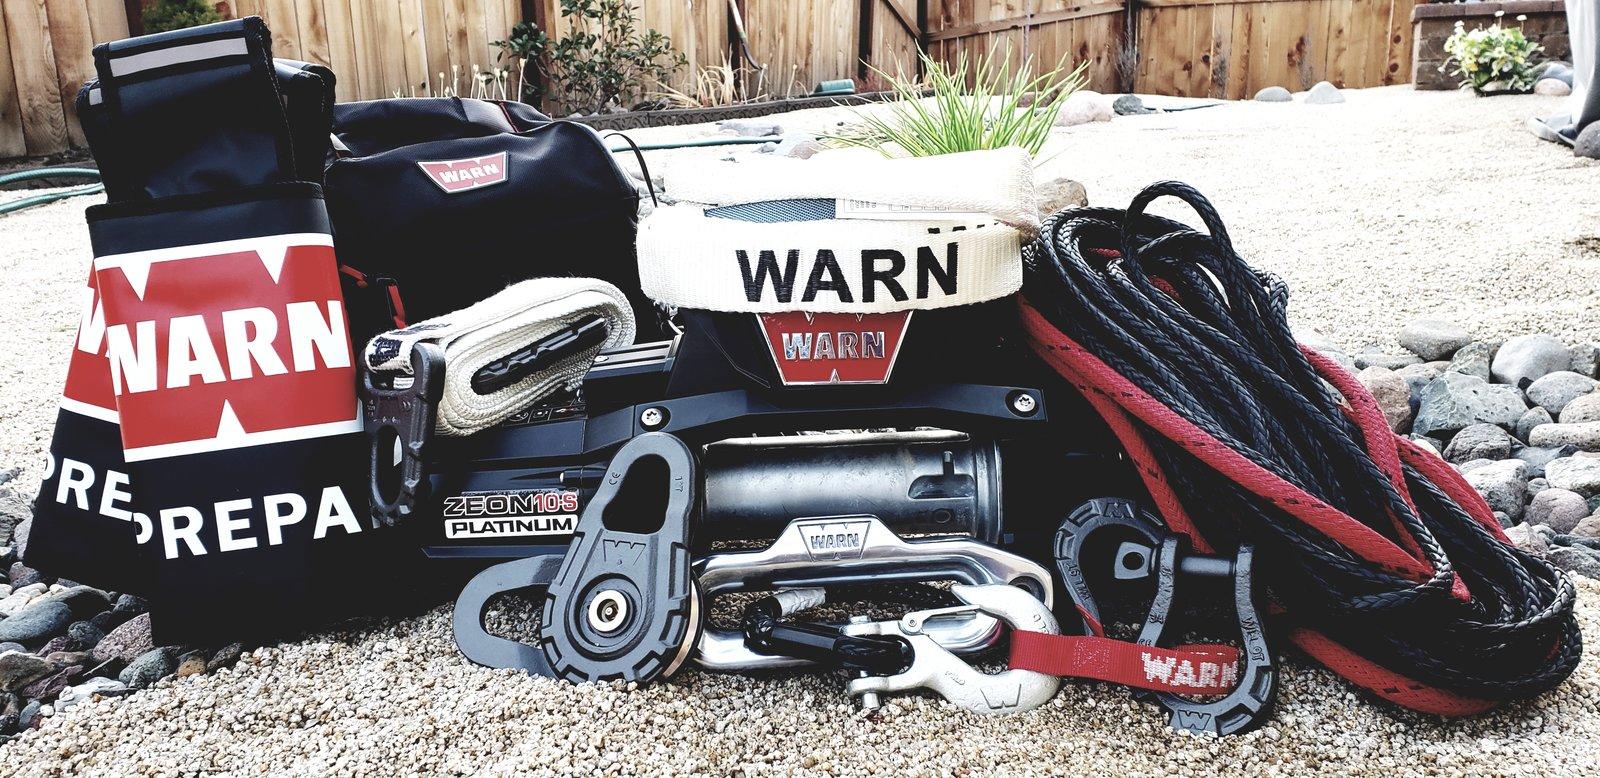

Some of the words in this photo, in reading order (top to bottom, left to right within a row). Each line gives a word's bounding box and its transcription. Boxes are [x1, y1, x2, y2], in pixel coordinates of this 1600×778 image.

[439, 163, 499, 183] WARN
[735, 242, 958, 303] WARN
[781, 331, 886, 360] WARN
[132, 485, 378, 559] REPA
[452, 517, 573, 536] PLATINUM
[810, 533, 859, 549] WARN
[1141, 652, 1238, 688] WARN
